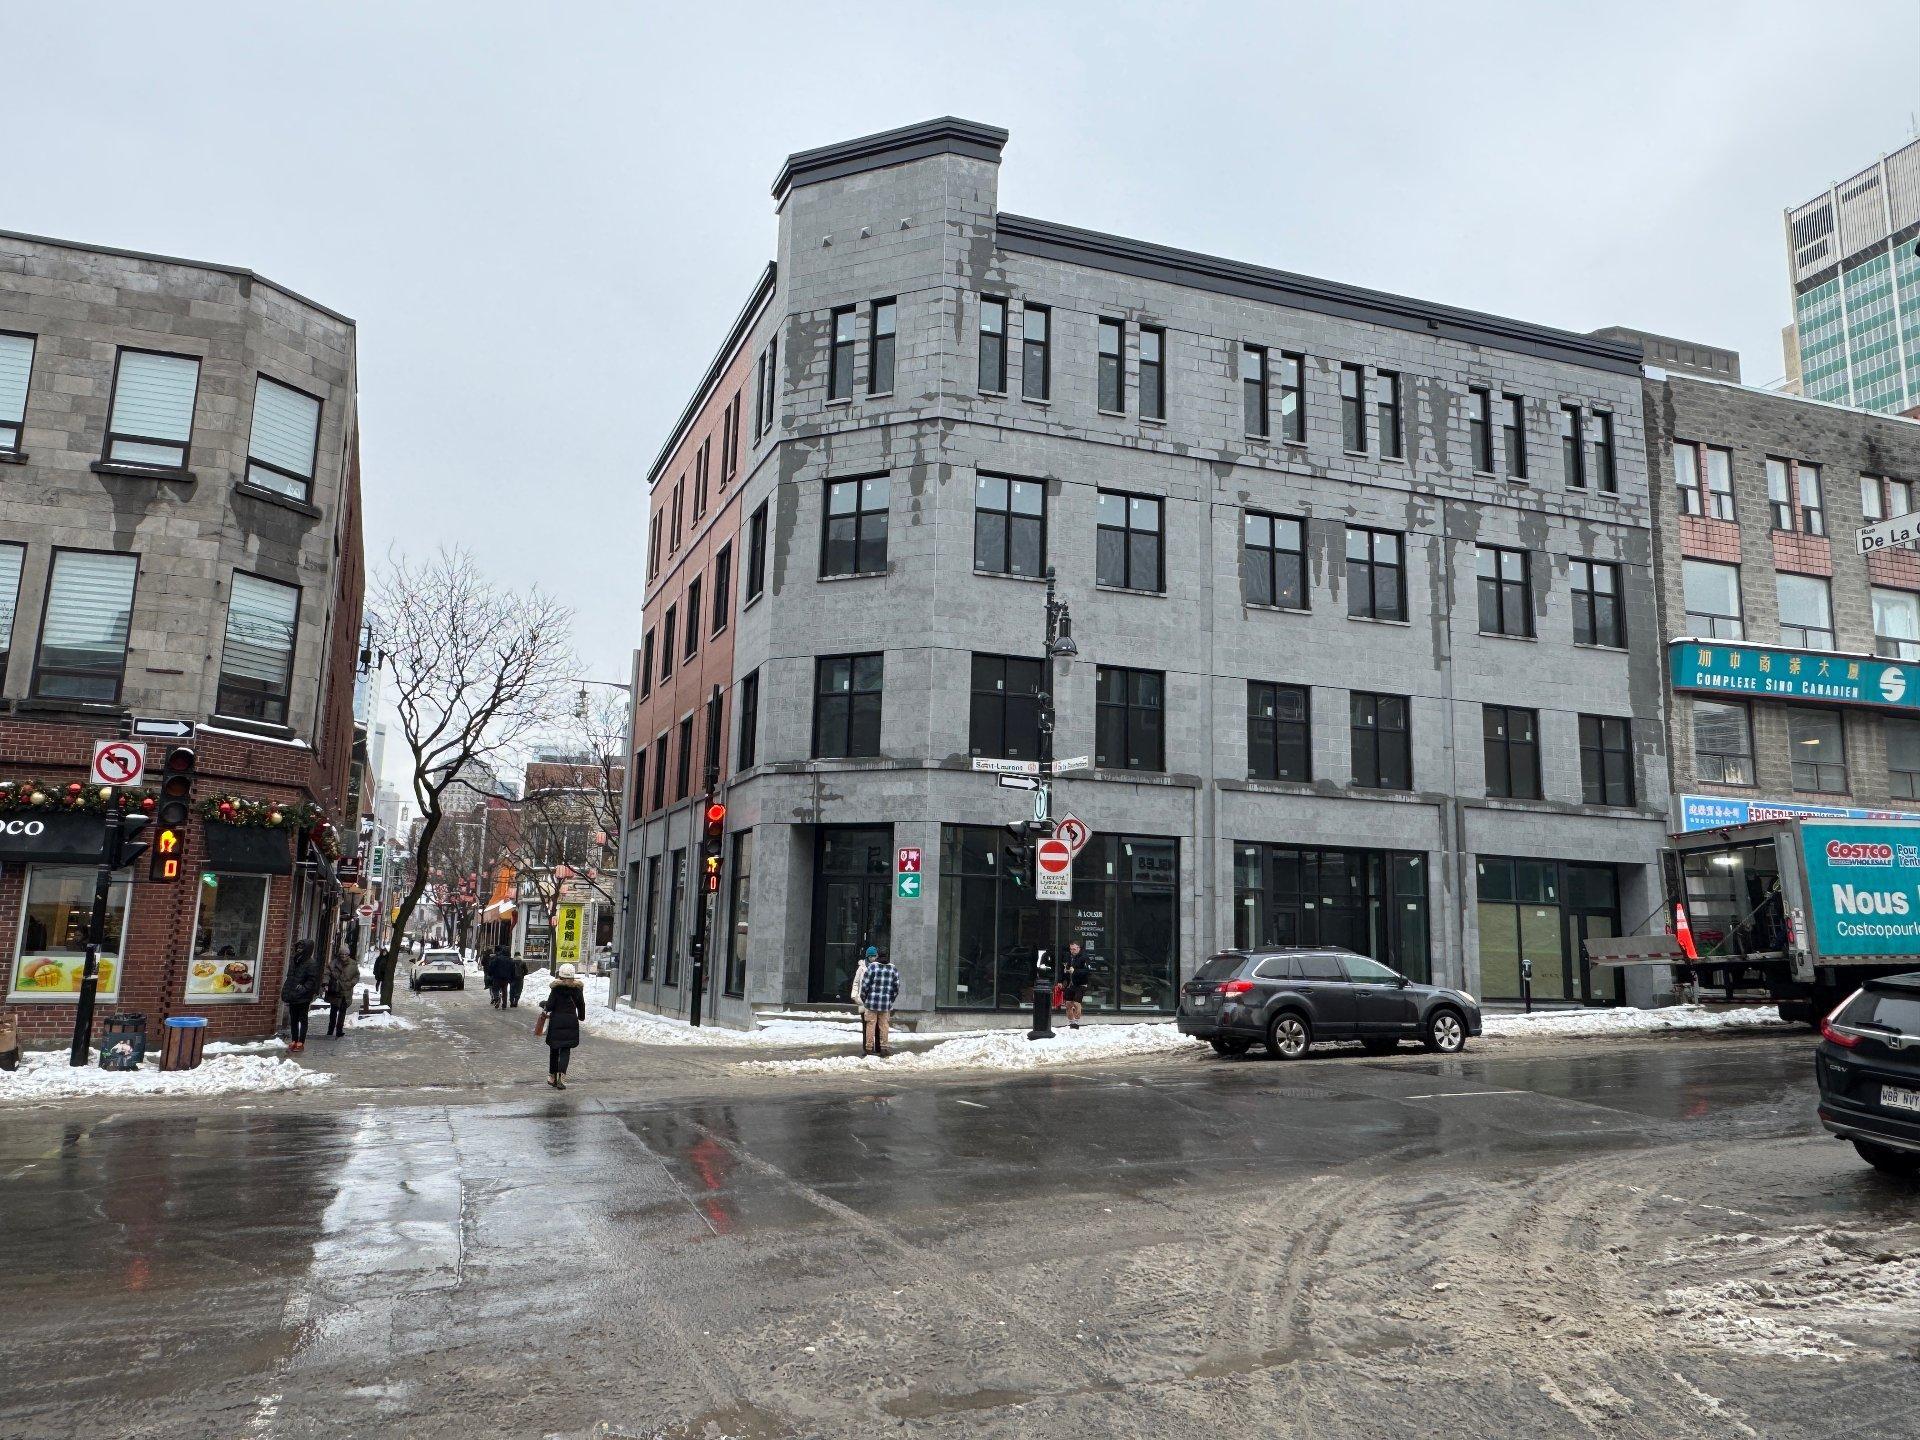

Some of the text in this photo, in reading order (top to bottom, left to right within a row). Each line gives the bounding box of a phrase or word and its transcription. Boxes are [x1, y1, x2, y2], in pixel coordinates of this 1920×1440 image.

[1861, 528, 1876, 536] Rue
[1862, 529, 1910, 551] De La
[1898, 845, 1917, 855] Pour
[1899, 856, 1920, 866] l'ent
[1832, 883, 1910, 915] Nous
[1837, 921, 1920, 939] Costcopourl
